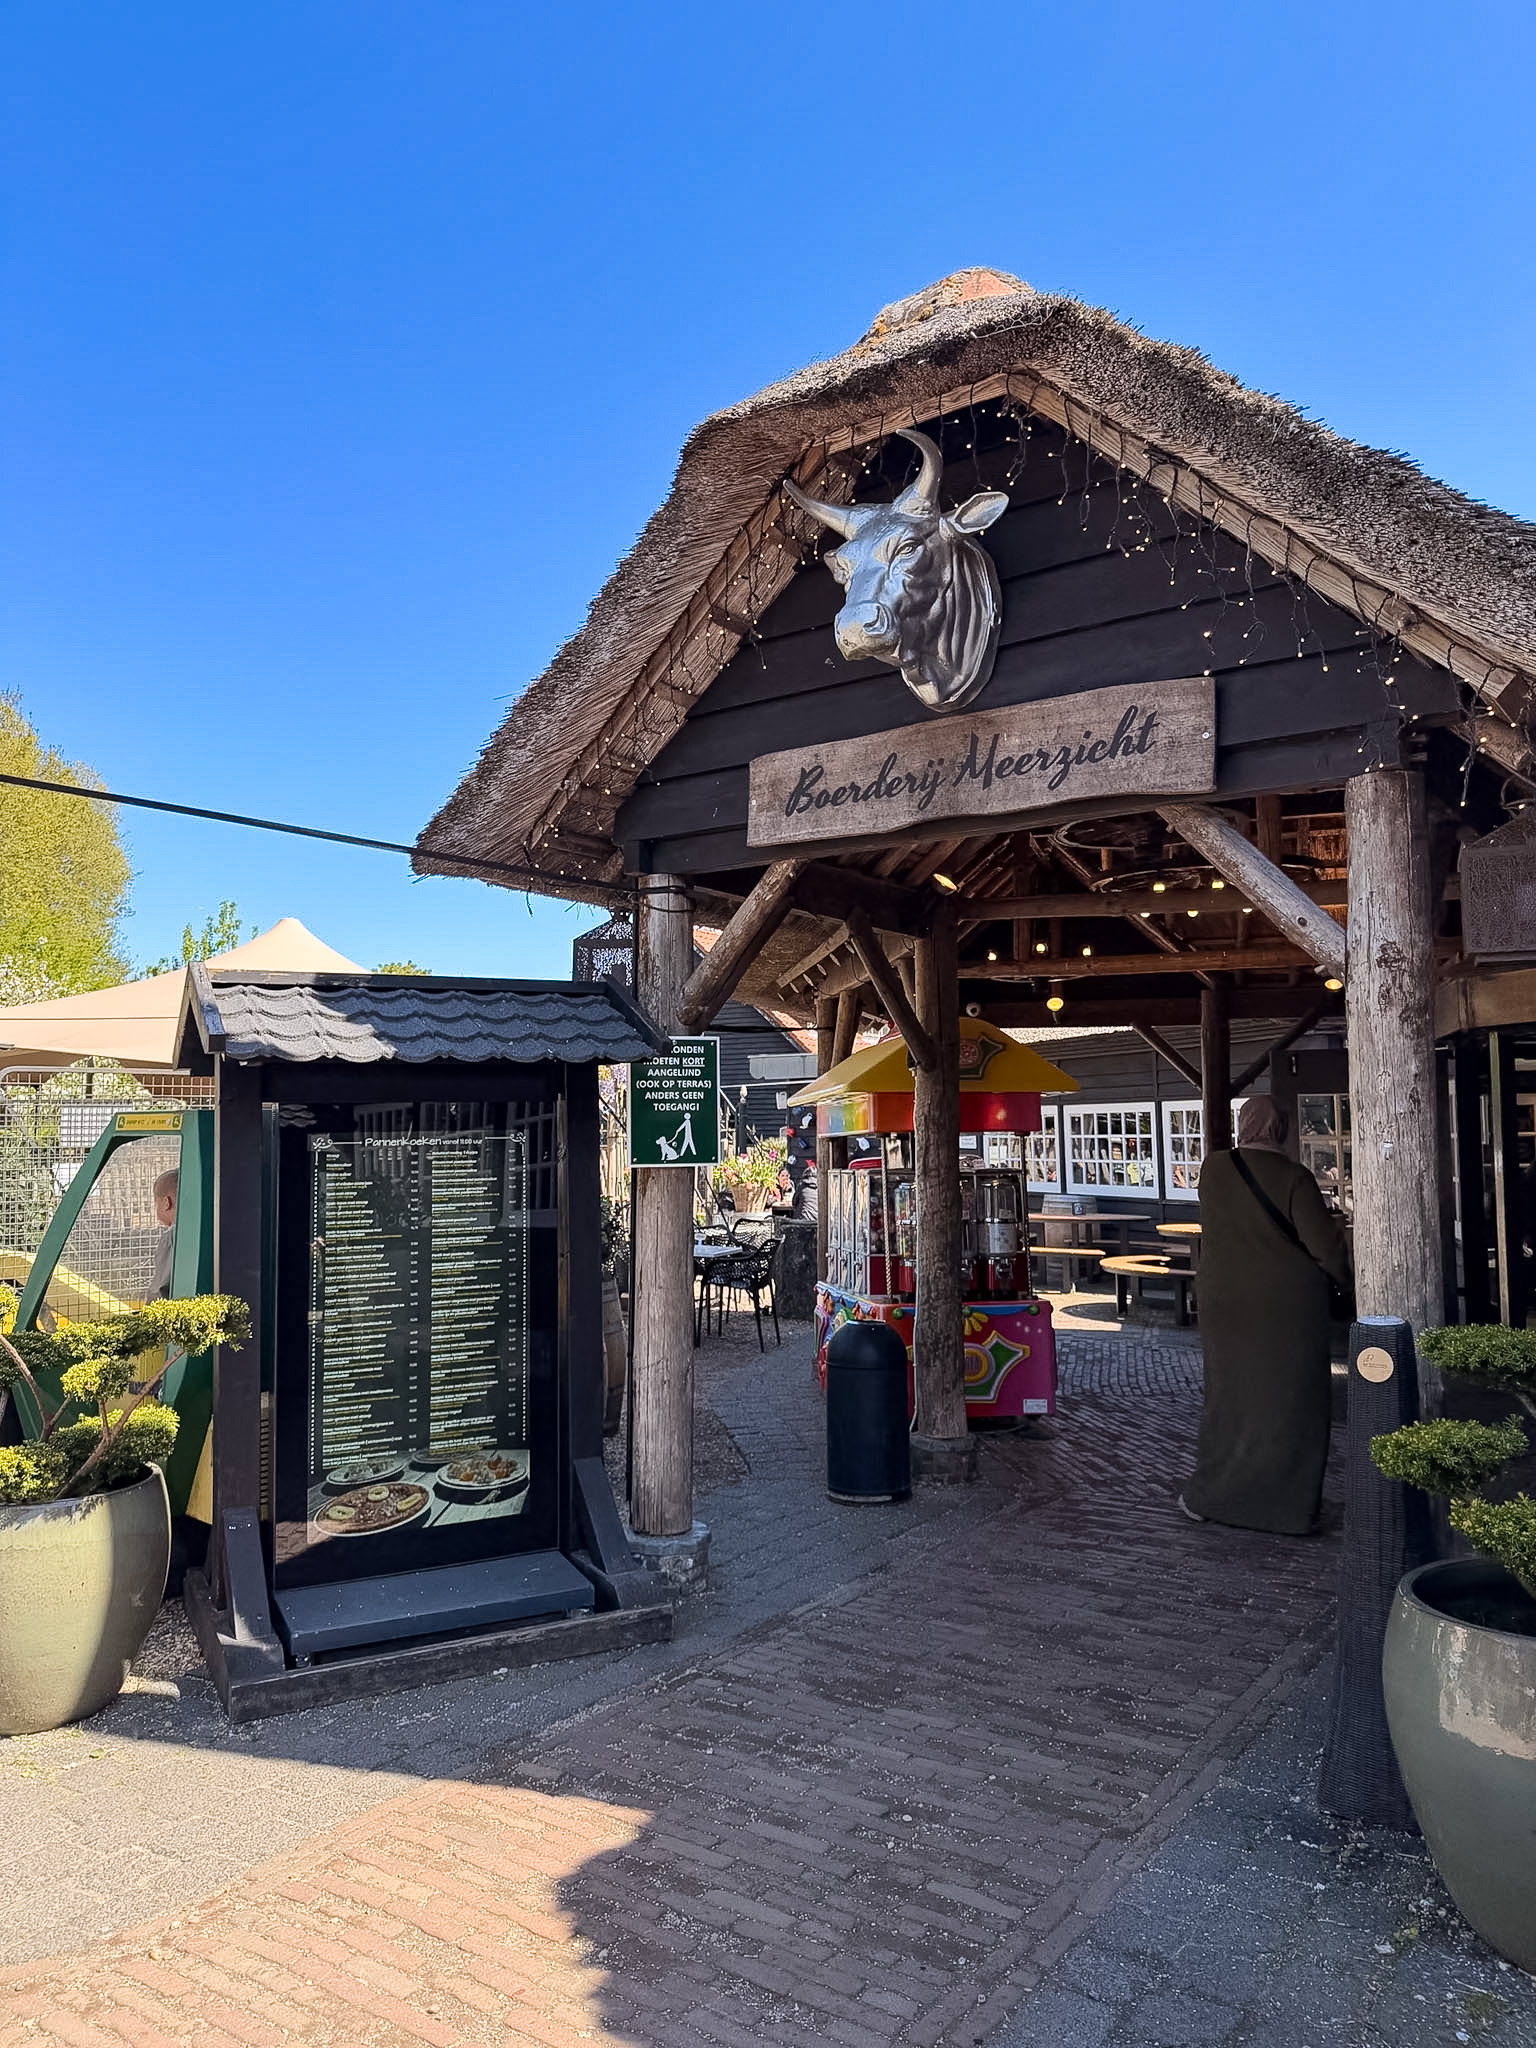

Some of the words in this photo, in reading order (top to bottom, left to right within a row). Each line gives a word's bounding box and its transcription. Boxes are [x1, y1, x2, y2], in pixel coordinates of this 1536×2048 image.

[785, 752, 946, 818] Boerderij
[951, 704, 1161, 791] Meerzicht
[670, 1045, 704, 1054] ONDEN
[643, 1057, 680, 1065] OETEN
[682, 1056, 705, 1066] KORT
[636, 1080, 660, 1089] (OOK
[662, 1080, 675, 1088] OP
[677, 1080, 712, 1089] TERRAS)
[645, 1092, 680, 1100] ANDERS
[682, 1092, 704, 1100] GEEN
[364, 1136, 442, 1147] Pannenkoeken
